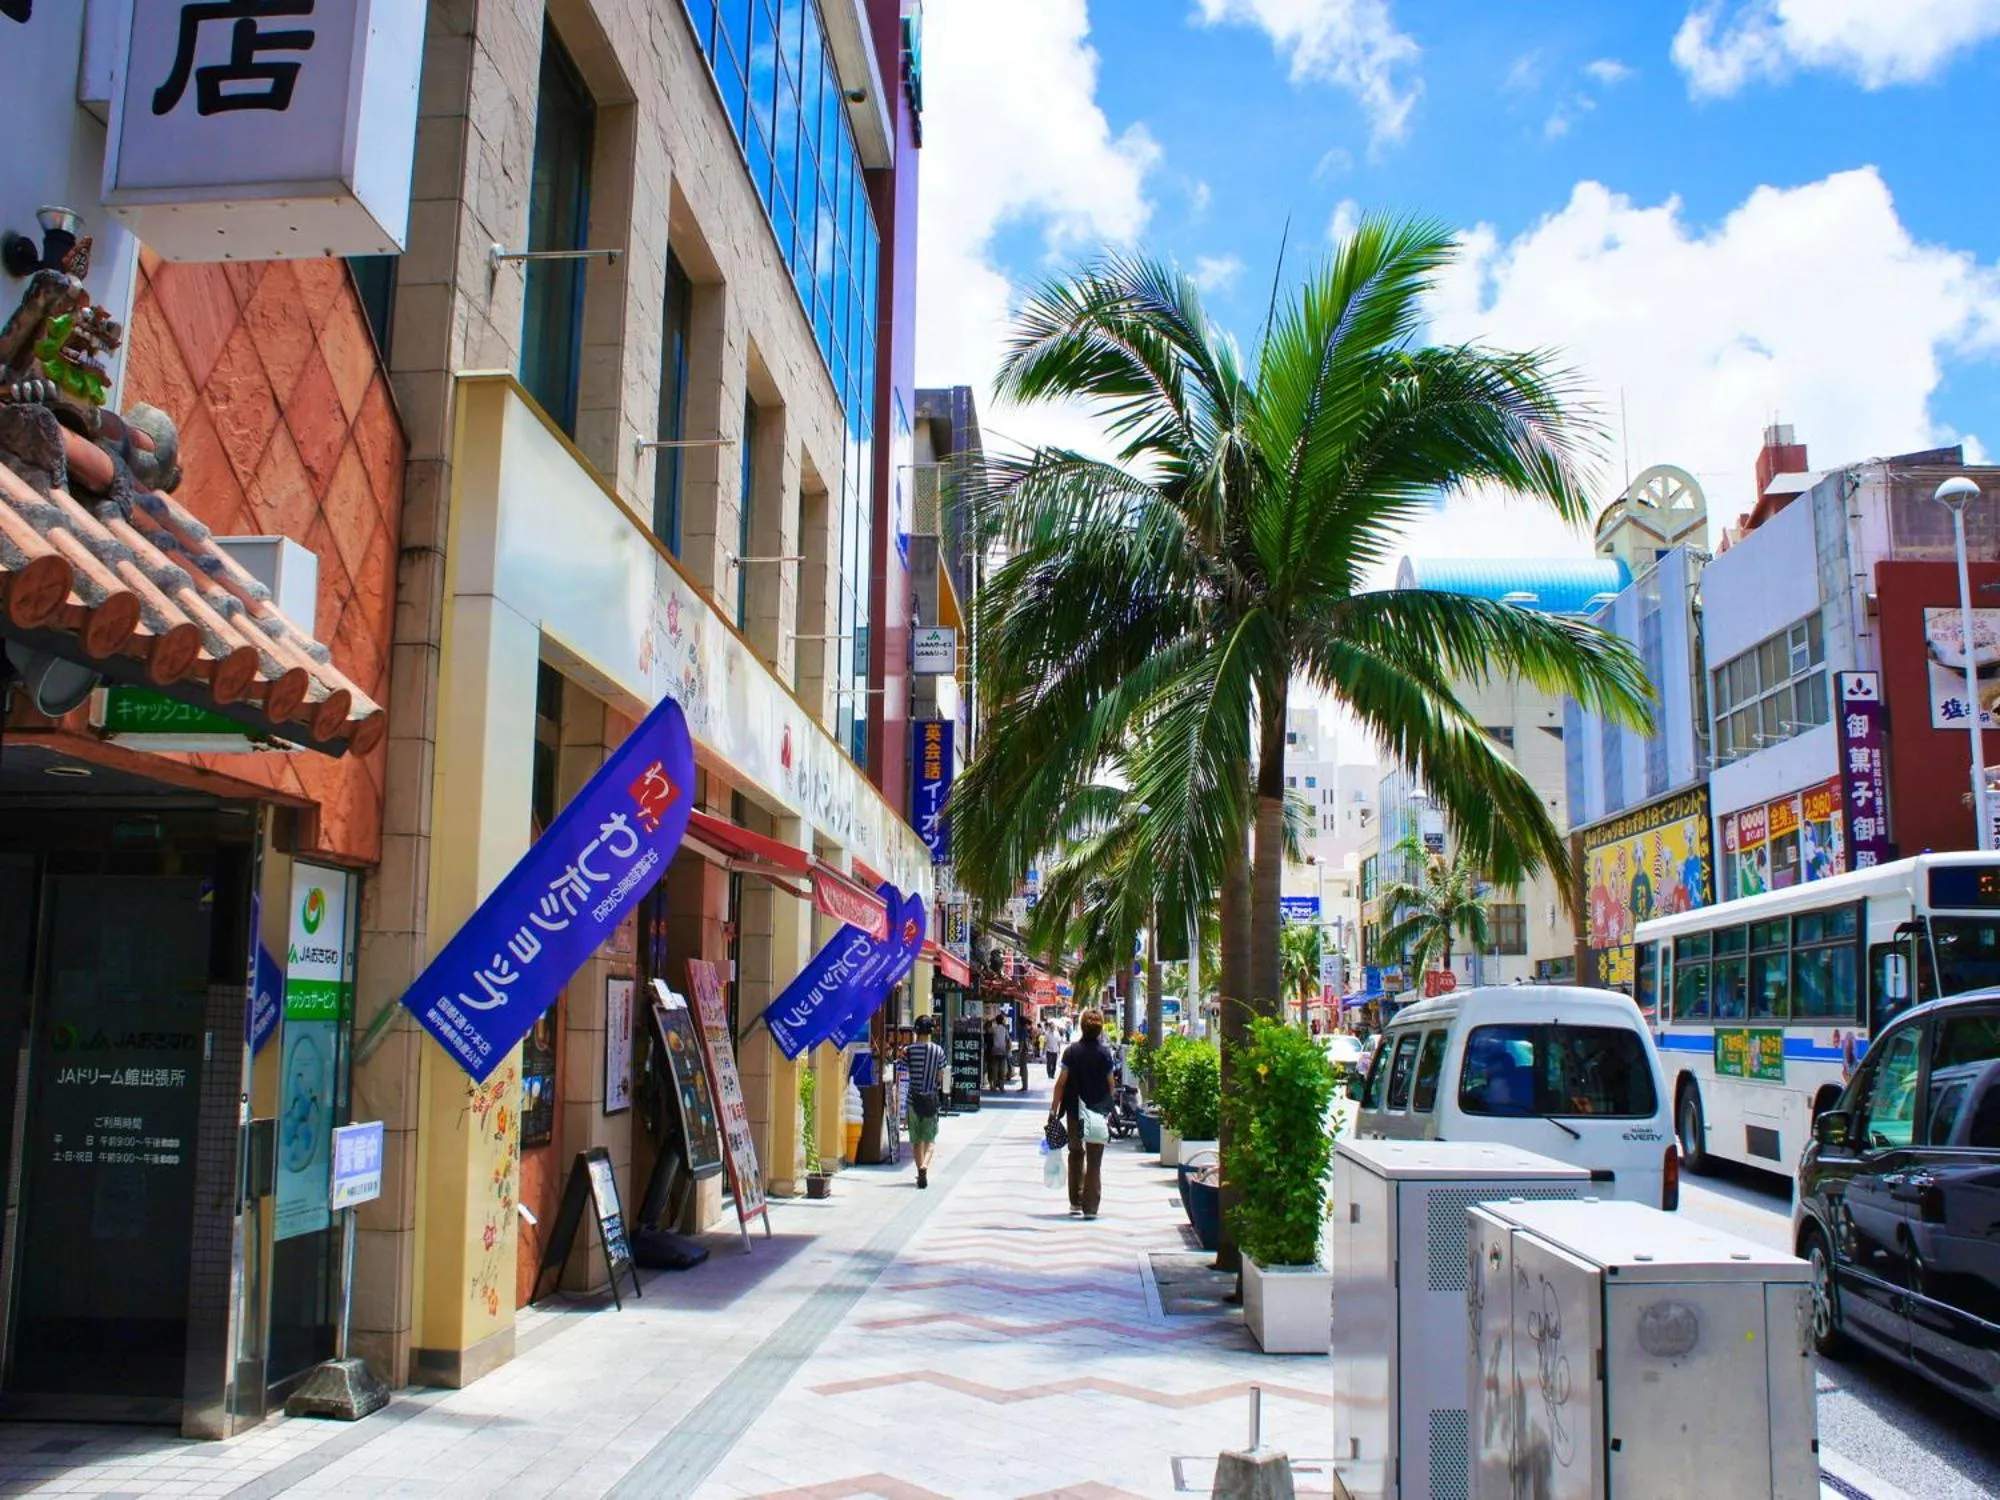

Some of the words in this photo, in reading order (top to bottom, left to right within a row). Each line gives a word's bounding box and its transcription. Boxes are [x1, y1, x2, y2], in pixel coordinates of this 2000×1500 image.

[152, 0, 316, 117] 店
[924, 724, 941, 780] 英会話
[1846, 713, 1877, 867] 御菓子御殿
[56, 1067, 187, 1088] JAドリーム館出張所
[1622, 1132, 1663, 1141] EVERY
